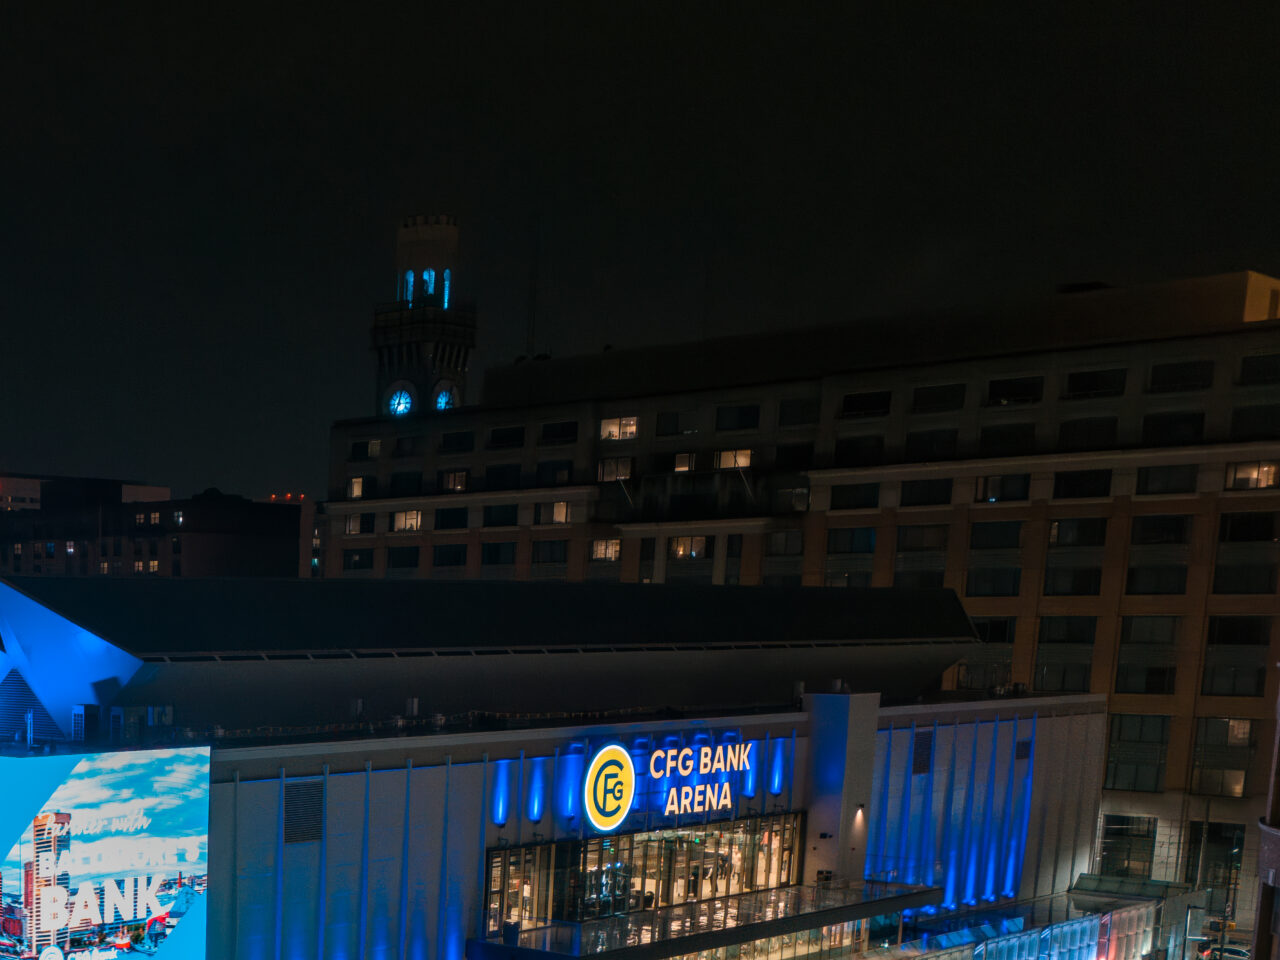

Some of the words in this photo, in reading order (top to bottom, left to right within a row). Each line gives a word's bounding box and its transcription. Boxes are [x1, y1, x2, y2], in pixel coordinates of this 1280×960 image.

[649, 747, 694, 780] CFG
[699, 743, 753, 775] BANK
[664, 781, 733, 816] ARENA
[40, 873, 171, 932] BANK
